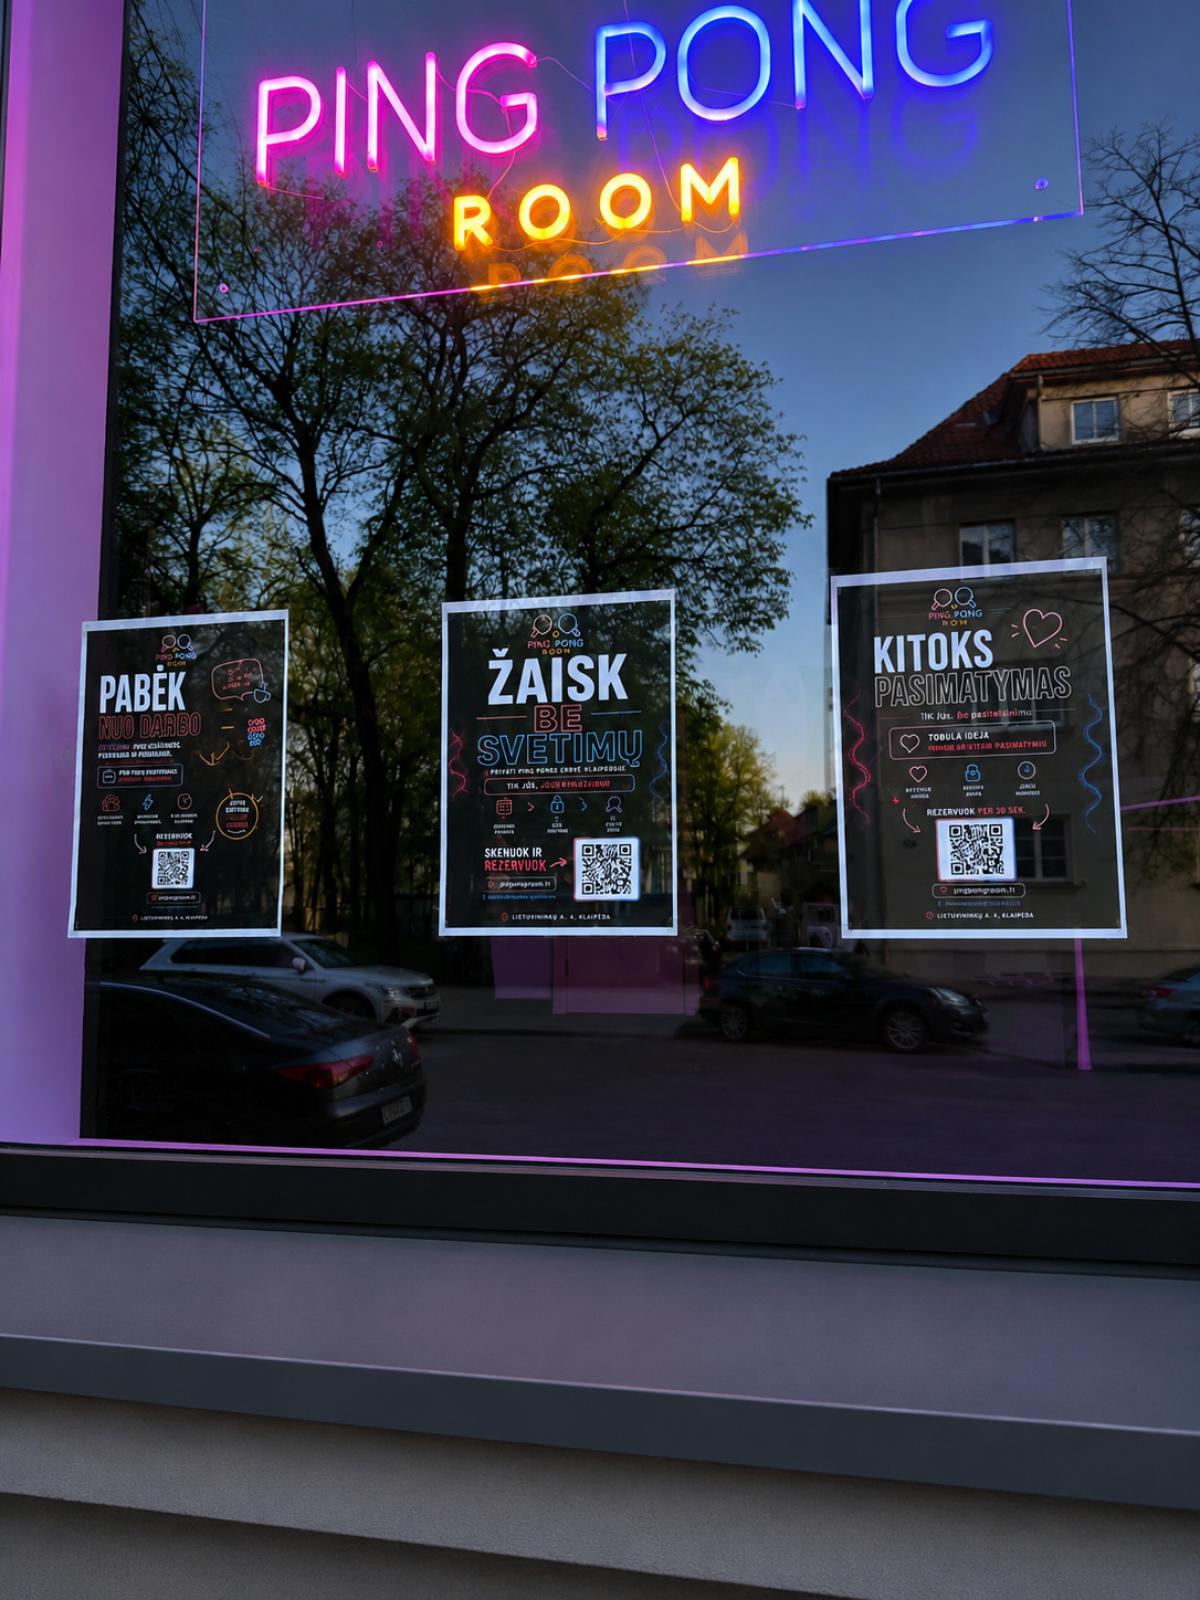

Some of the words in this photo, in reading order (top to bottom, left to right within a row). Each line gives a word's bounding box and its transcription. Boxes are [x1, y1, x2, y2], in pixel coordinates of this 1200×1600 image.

[255, 42, 538, 188] PING
[595, 0, 995, 140] PONG
[453, 157, 740, 252] ROOM
[527, 640, 551, 649] PING
[554, 638, 584, 648] PONG
[873, 629, 993, 674] KITOKS
[99, 664, 187, 714] PABĖK
[487, 647, 629, 706] ŽAISK
[874, 665, 1072, 708] PASIMATYMAS
[98, 715, 135, 740] NUO
[533, 703, 583, 734] BE
[476, 729, 643, 768] SVETIMŲ
[926, 807, 976, 817] REZERVUOK
[484, 847, 529, 858] SKENUOK
[532, 847, 543, 858] IR
[484, 859, 547, 872] REZERVUOK
